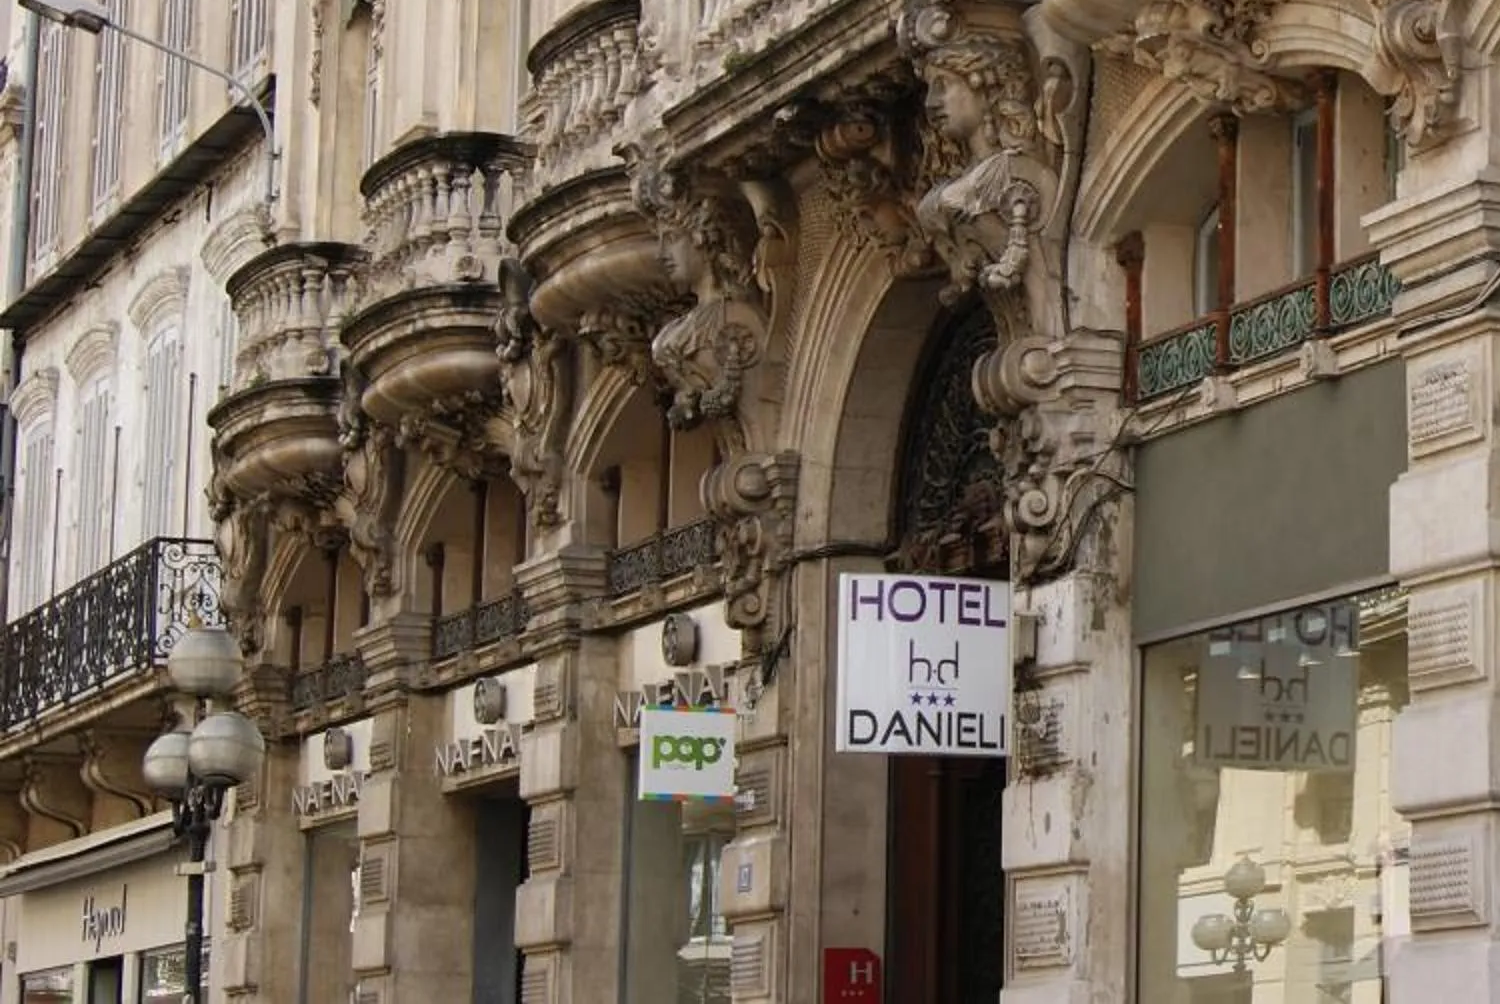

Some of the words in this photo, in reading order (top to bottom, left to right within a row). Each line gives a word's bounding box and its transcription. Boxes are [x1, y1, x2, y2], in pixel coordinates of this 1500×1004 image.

[851, 579, 1006, 628] HOTEL
[434, 725, 523, 776] NAFNA
[849, 709, 1006, 750] DANIELI
[850, 961, 873, 985] H
